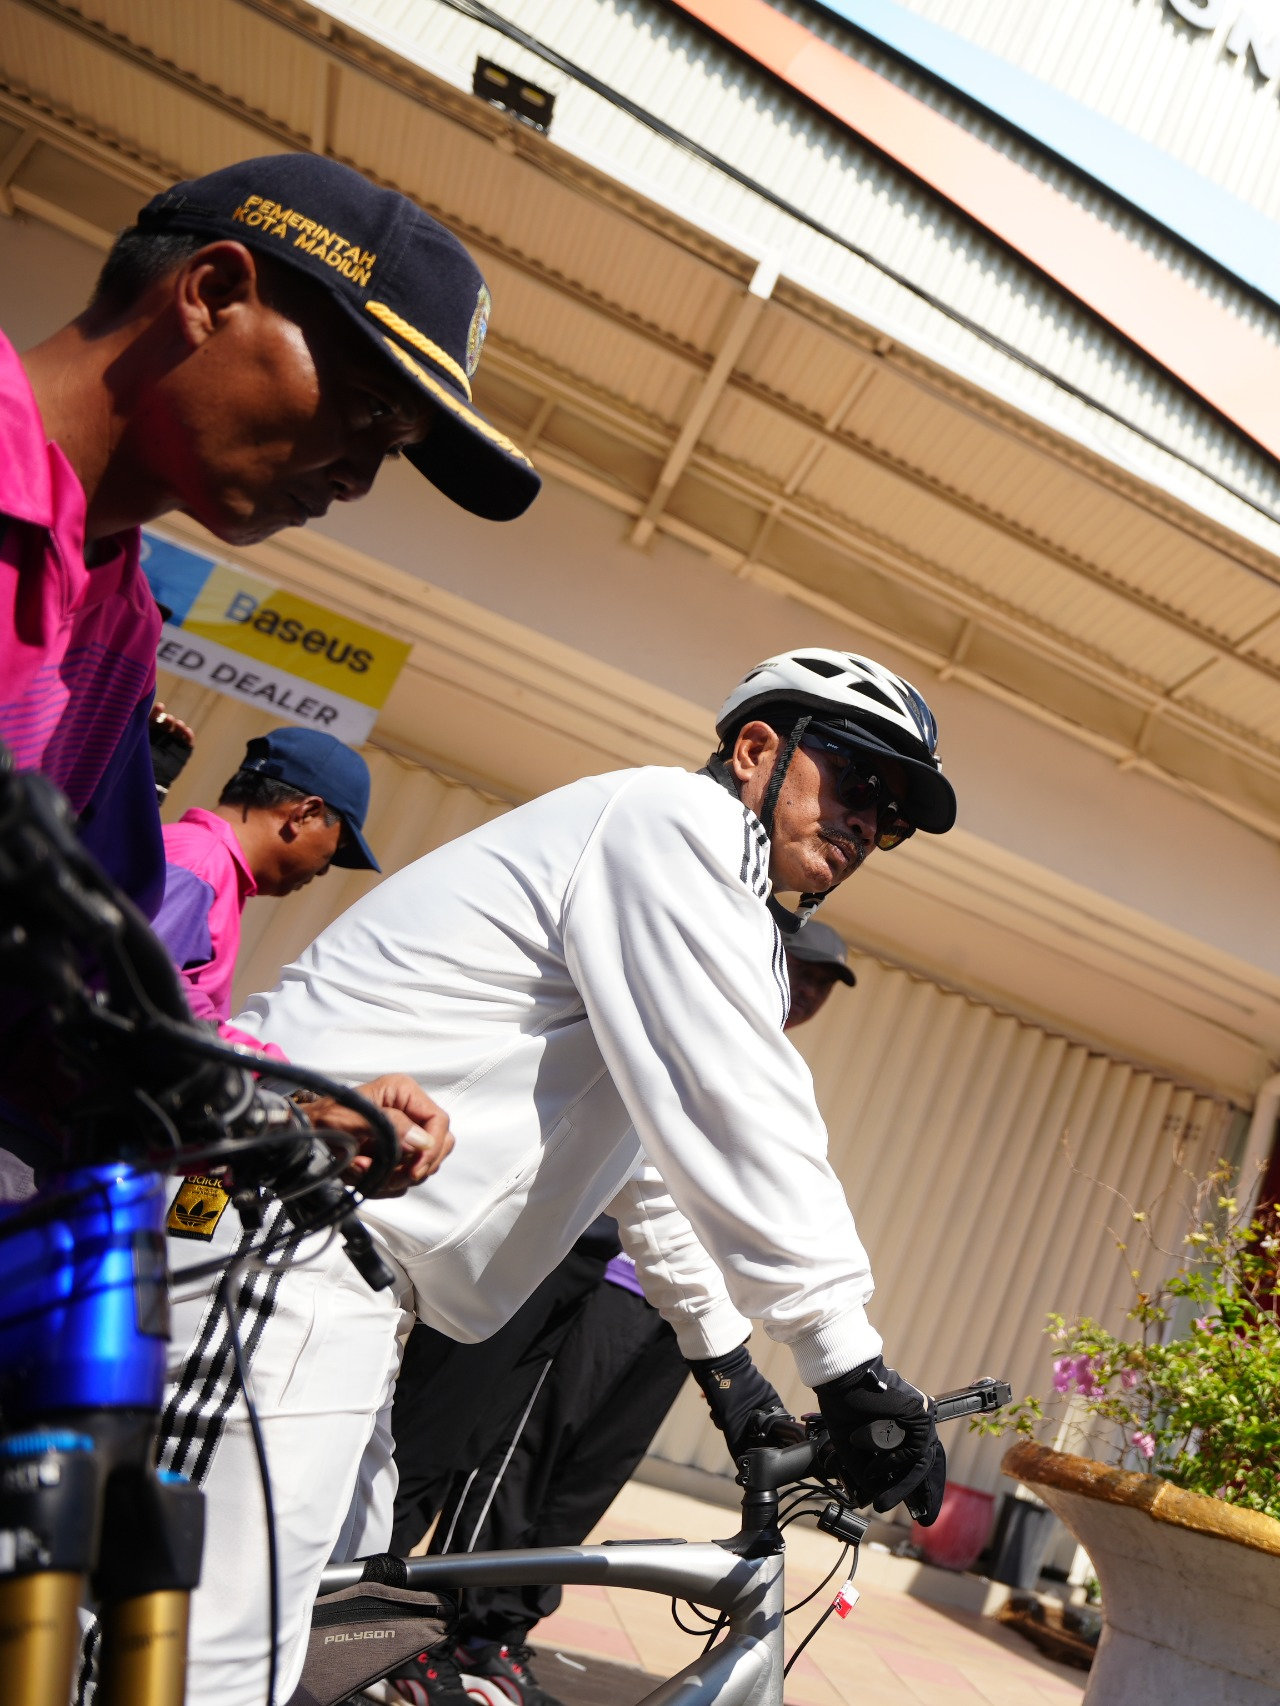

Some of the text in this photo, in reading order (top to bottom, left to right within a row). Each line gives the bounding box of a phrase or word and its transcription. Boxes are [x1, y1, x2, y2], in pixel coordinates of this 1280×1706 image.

[232, 206, 372, 288] KOTA MADIUN
[245, 194, 377, 270] PEMERINTAH
[224, 589, 375, 675] Baseus
[157, 639, 340, 727] ED DEALER
[324, 1630, 396, 1645] POLYGON
